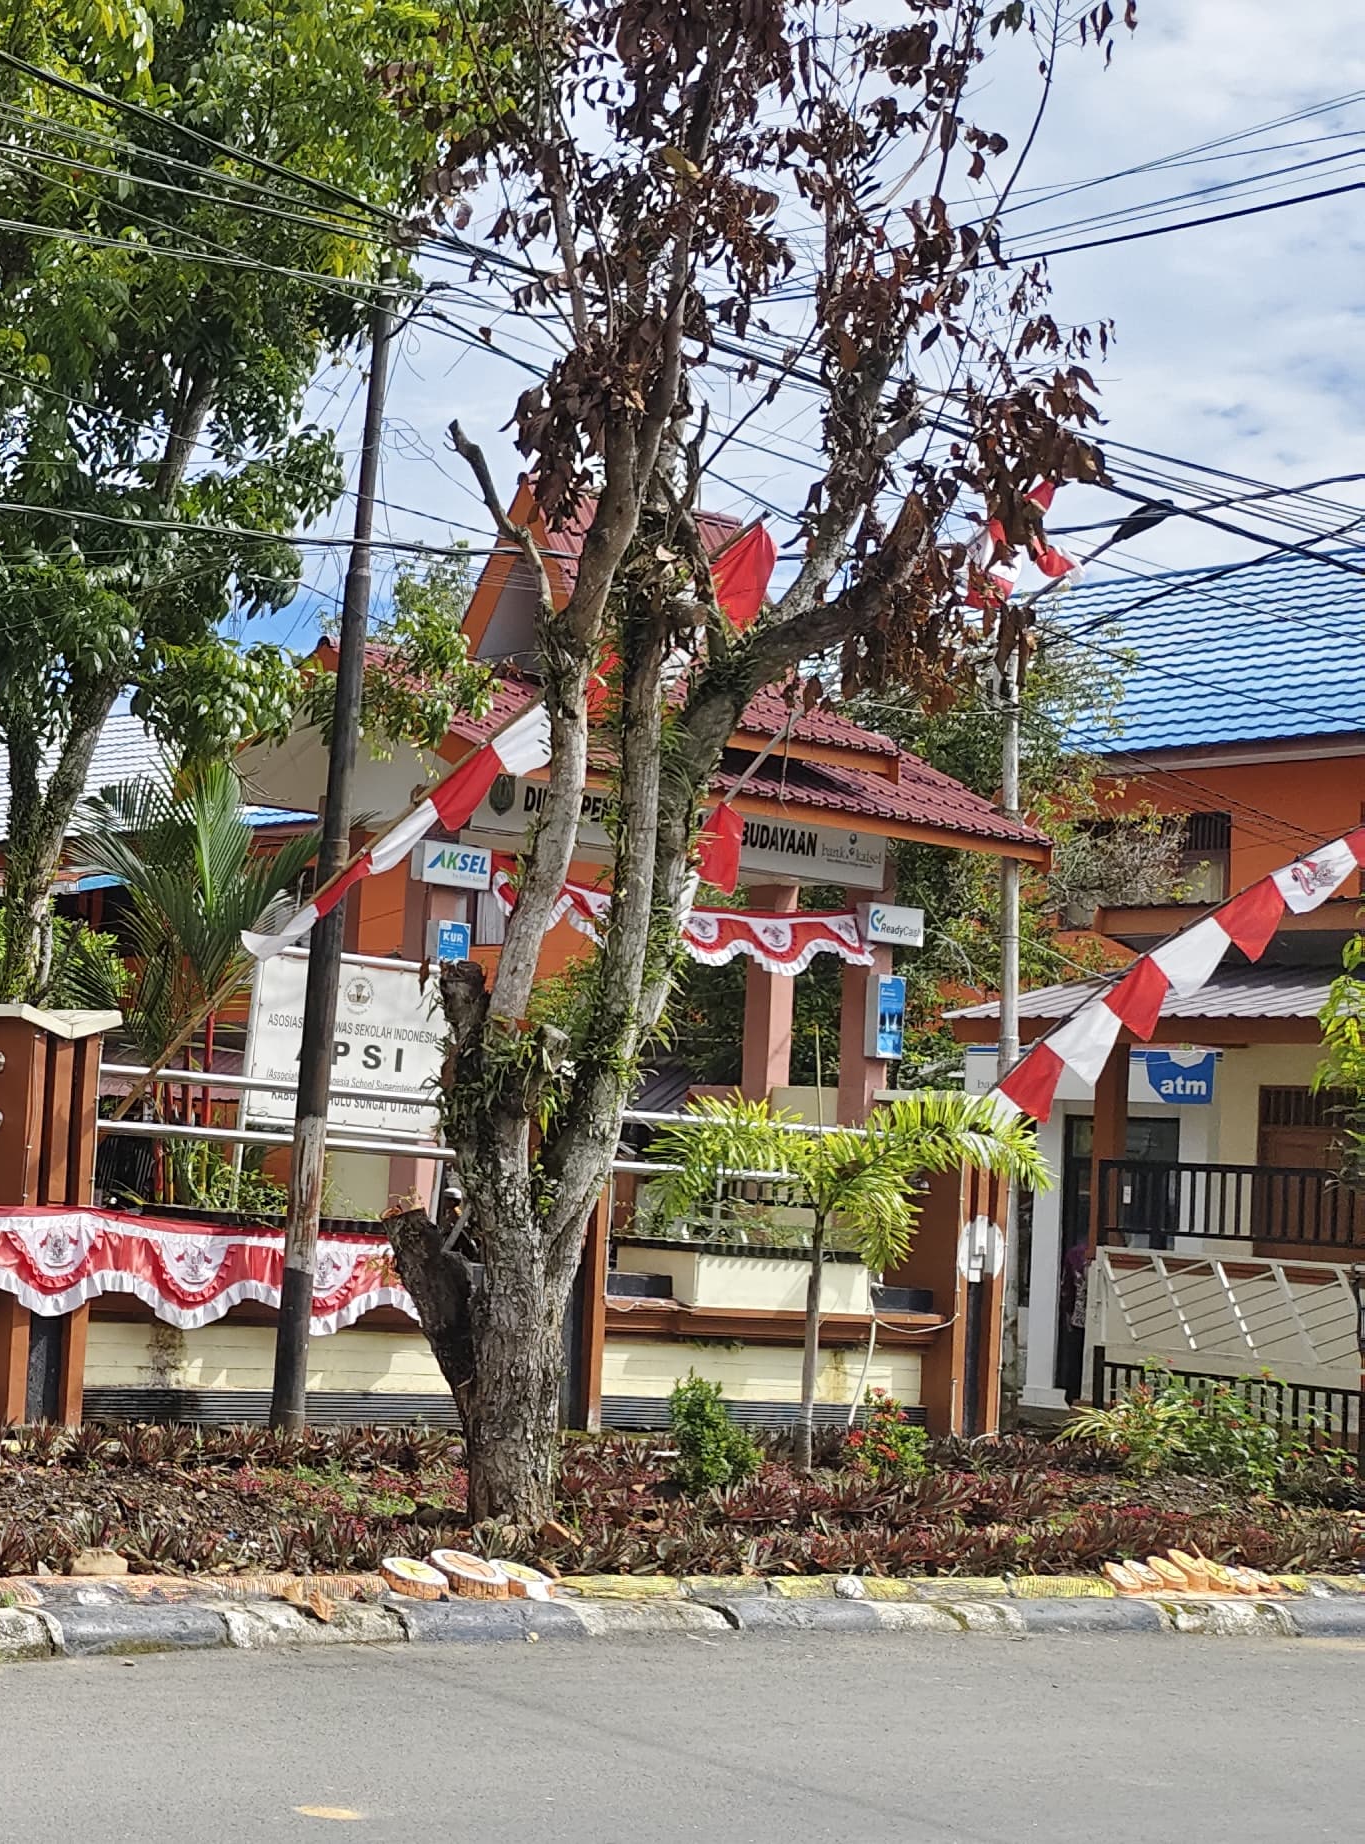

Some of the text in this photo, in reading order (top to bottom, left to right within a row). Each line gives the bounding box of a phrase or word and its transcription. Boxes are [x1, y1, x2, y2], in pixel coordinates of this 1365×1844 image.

[427, 848, 488, 875] AKSEL
[442, 930, 464, 943] KUR
[267, 1013, 303, 1029] ASOSIAS
[354, 1023, 392, 1039] SEKOLAH
[393, 1030, 438, 1045] INDONESIA
[1160, 1075, 1207, 1096] atm
